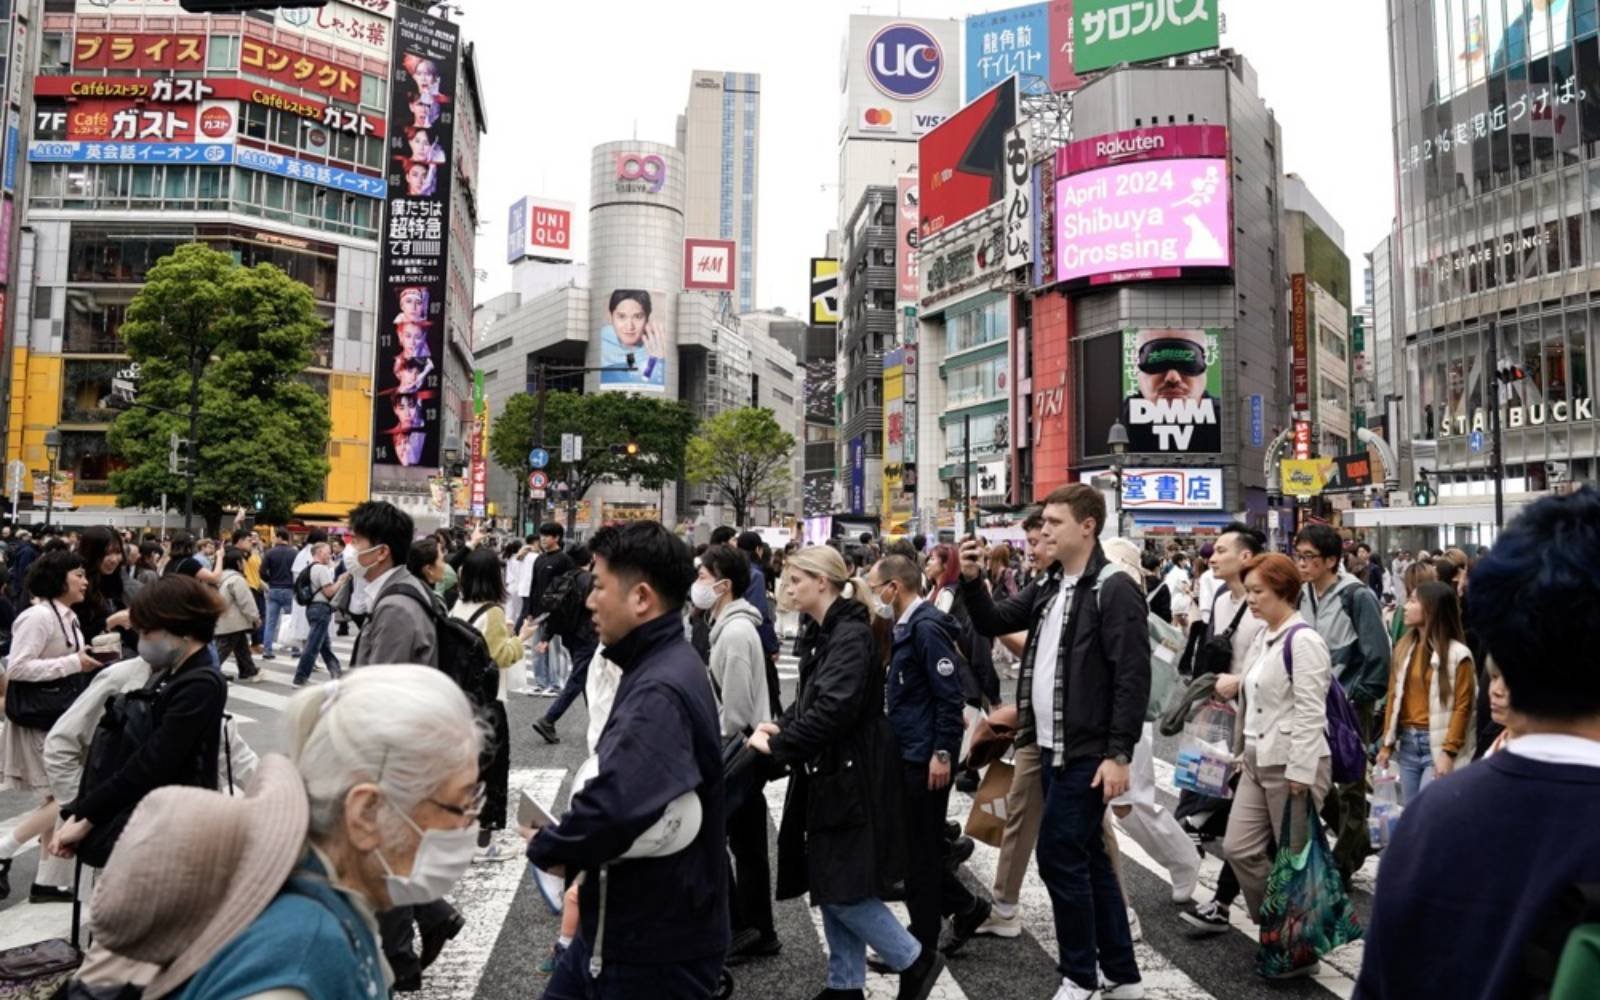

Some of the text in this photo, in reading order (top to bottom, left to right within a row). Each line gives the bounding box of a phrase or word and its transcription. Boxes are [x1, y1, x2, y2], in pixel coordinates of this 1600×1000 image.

[77, 37, 202, 62] プライス
[242, 41, 358, 93] コンタクト
[151, 78, 213, 101] ガスト
[38, 111, 68, 131] 7F
[74, 112, 108, 126] Café
[111, 108, 189, 140] ガスト
[323, 106, 375, 135] ガスト
[35, 143, 74, 156] AEON
[86, 144, 200, 160] 英会話イーオン
[1096, 134, 1164, 158] Rakuten
[286, 159, 384, 194] 英会話イーオン
[615, 153, 666, 193] 109
[1007, 128, 1030, 262] もんじゃ
[1064, 168, 1174, 208] April 2024
[389, 217, 442, 239] 超特急
[537, 211, 565, 228] UNI
[1064, 206, 1163, 240] Shibuya
[536, 228, 566, 244] QLO
[1063, 232, 1178, 270] Crossing
[1129, 398, 1217, 424] DMM
[1152, 425, 1194, 450] TV
